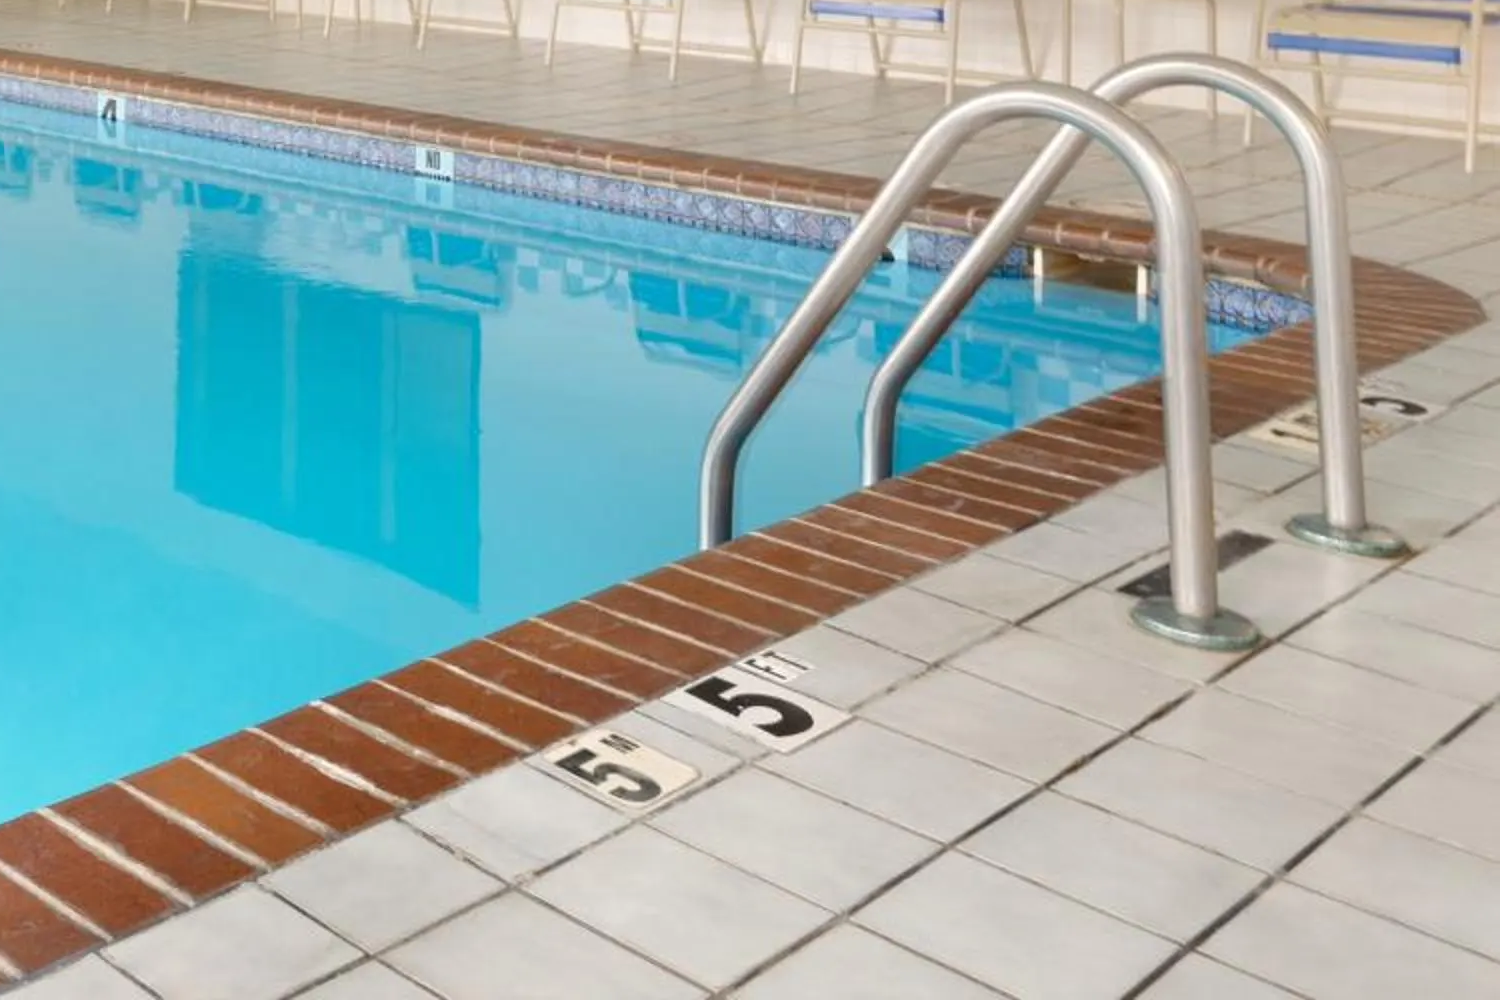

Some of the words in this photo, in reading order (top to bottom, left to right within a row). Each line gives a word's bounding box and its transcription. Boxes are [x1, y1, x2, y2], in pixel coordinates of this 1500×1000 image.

[743, 650, 810, 681] FT
[684, 673, 815, 737] 5
[554, 748, 662, 802] 5
